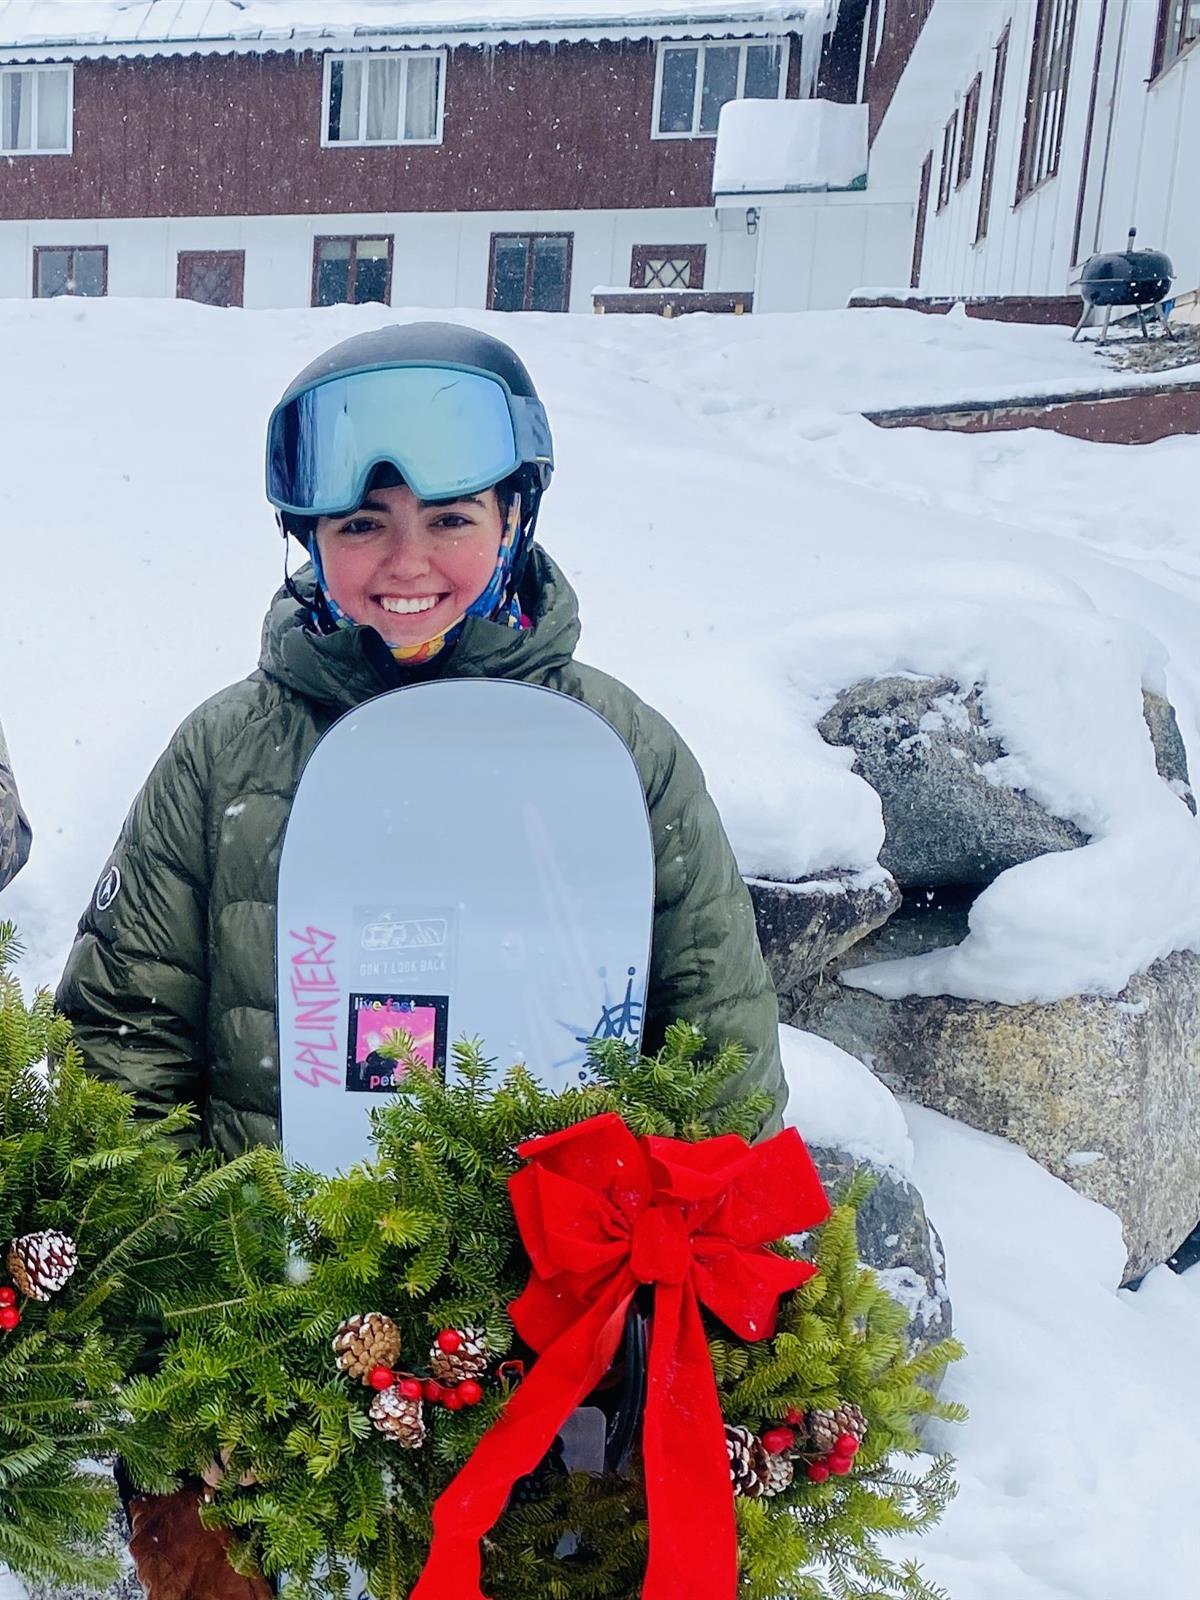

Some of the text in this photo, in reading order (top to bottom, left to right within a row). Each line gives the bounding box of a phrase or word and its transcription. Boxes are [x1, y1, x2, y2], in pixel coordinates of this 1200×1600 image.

[390, 960, 417, 974] LOOK
[419, 959, 447, 973] BACK
[289, 925, 341, 1088] SPLINTERS
[354, 997, 416, 1013] live fast
